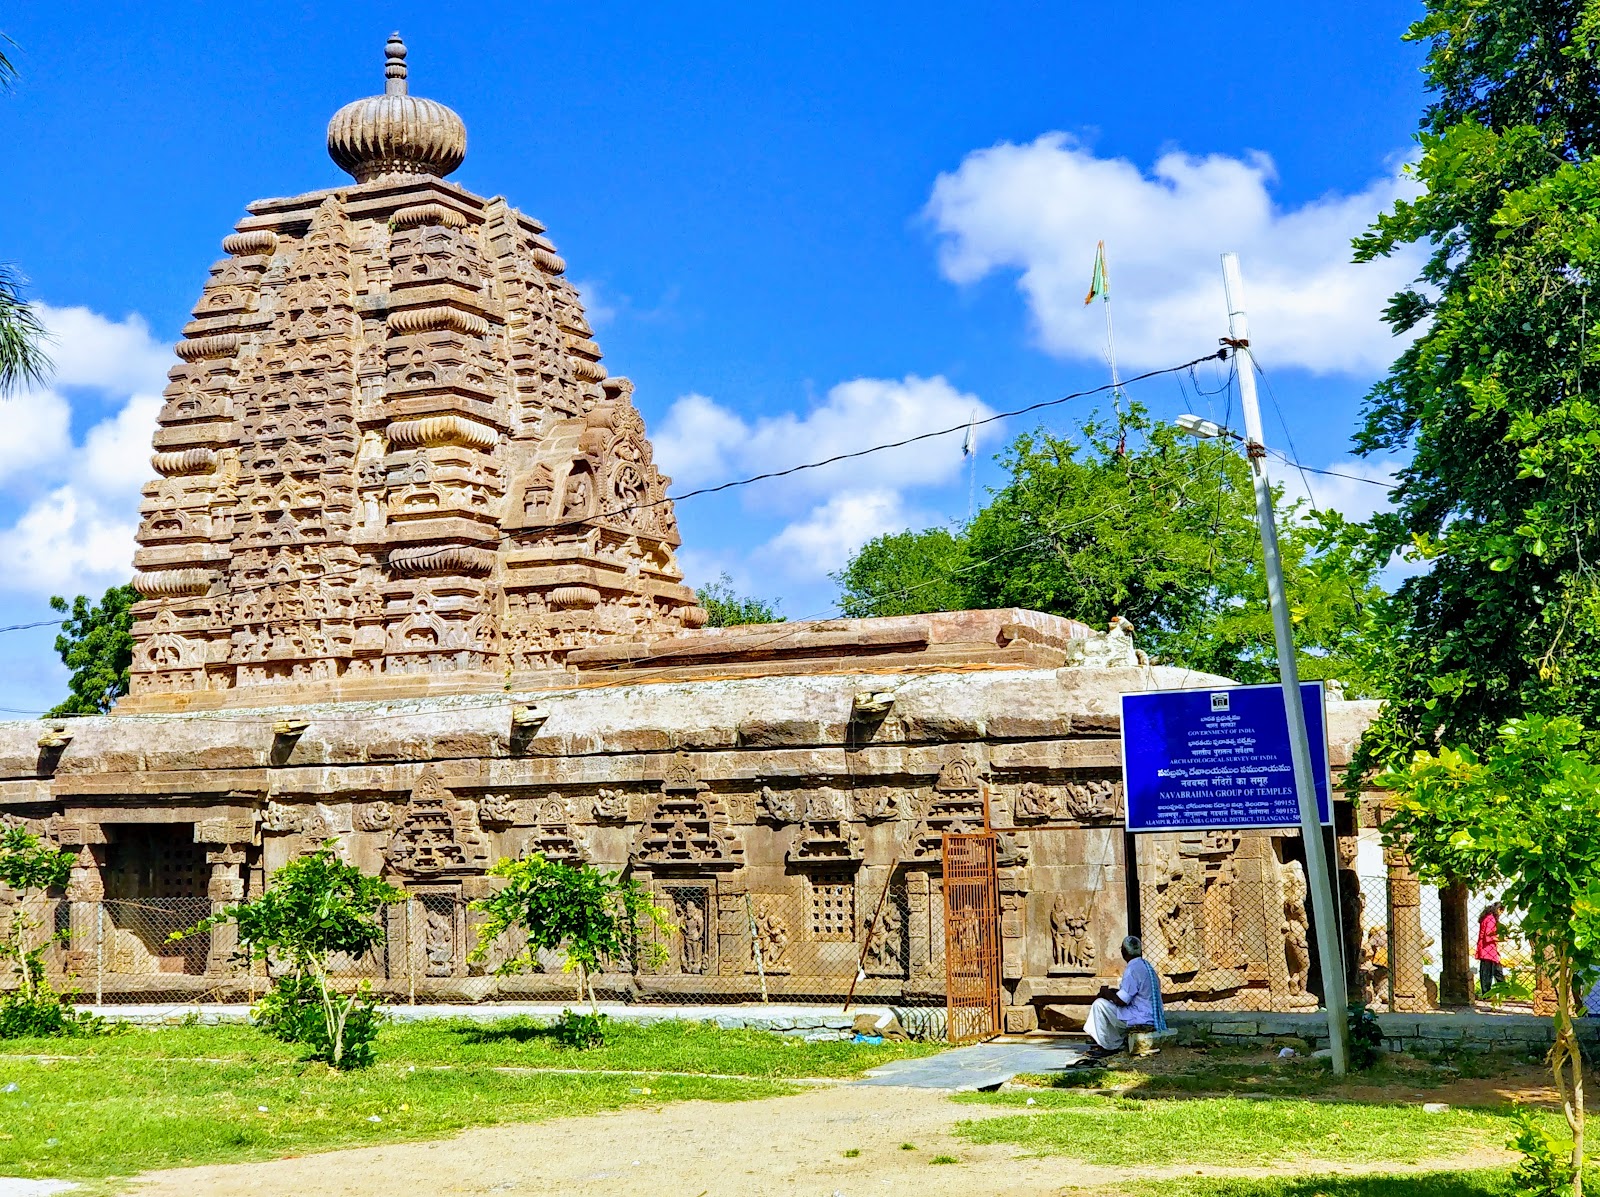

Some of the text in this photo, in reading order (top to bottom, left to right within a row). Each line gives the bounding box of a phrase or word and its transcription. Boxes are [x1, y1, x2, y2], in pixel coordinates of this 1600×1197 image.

[1188, 728, 1228, 736] GOVERNMENT
[1212, 776, 1232, 786] मंदिरों
[1236, 778, 1246, 786] का
[1250, 776, 1268, 787] समूह
[1160, 786, 1293, 800] NAVABRAHMA GROUP OF TEMPLES
